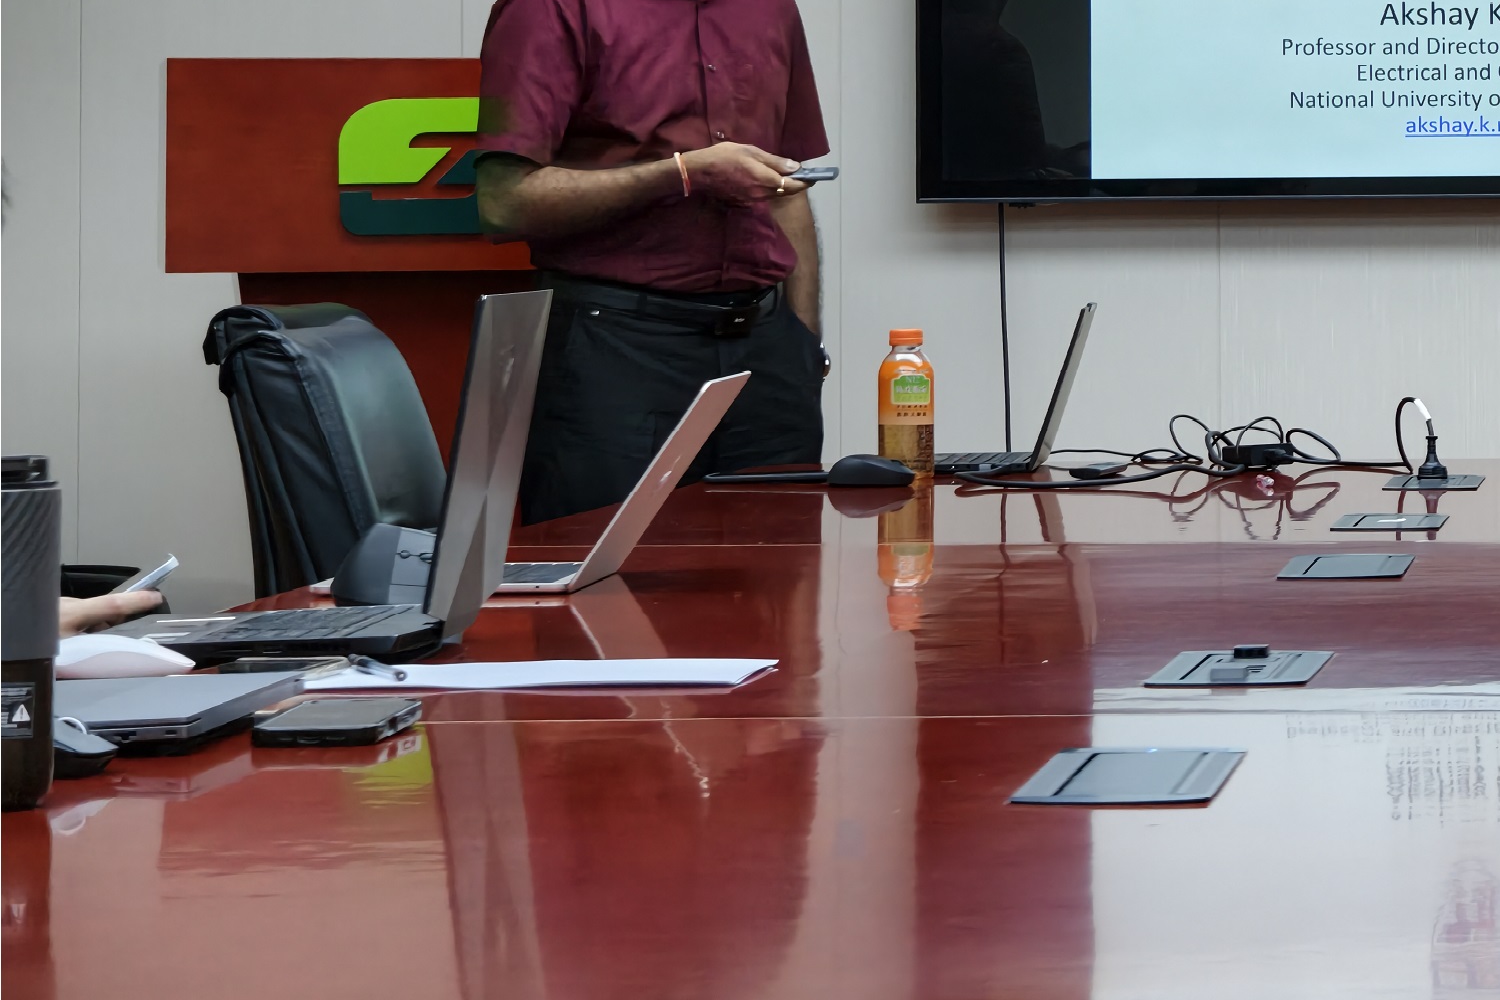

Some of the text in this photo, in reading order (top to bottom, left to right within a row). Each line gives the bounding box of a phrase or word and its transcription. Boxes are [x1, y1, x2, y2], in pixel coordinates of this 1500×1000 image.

[1379, 0, 1480, 29] Akshay
[1282, 37, 1377, 56] Professor
[1382, 36, 1419, 55] and
[1357, 63, 1447, 82] Electrical
[1454, 62, 1491, 81] and
[1290, 89, 1374, 109] National
[1381, 89, 1483, 112] University
